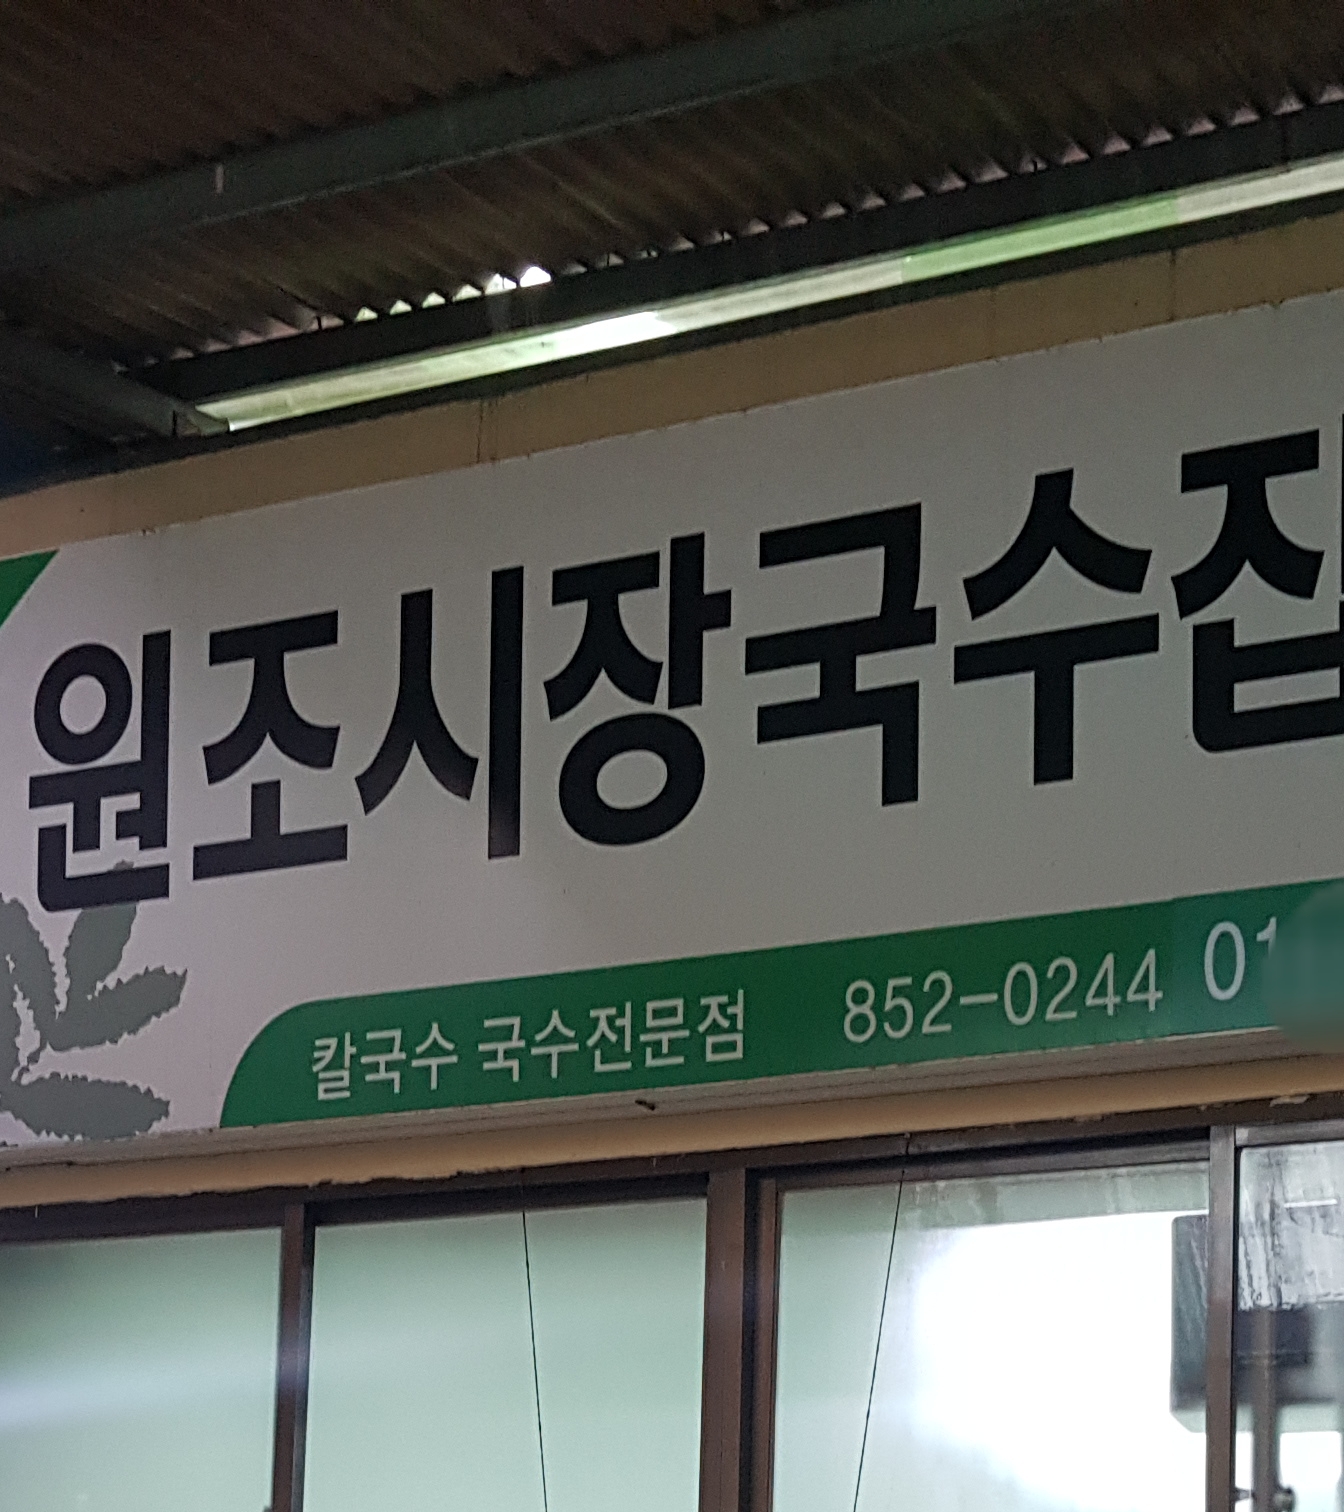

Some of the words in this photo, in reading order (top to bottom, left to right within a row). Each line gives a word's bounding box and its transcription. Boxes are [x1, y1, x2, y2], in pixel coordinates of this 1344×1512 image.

[311, 1022, 459, 1101] 칼국수
[478, 989, 747, 1083] 국수전문점
[843, 948, 1163, 1044] 852-0244
